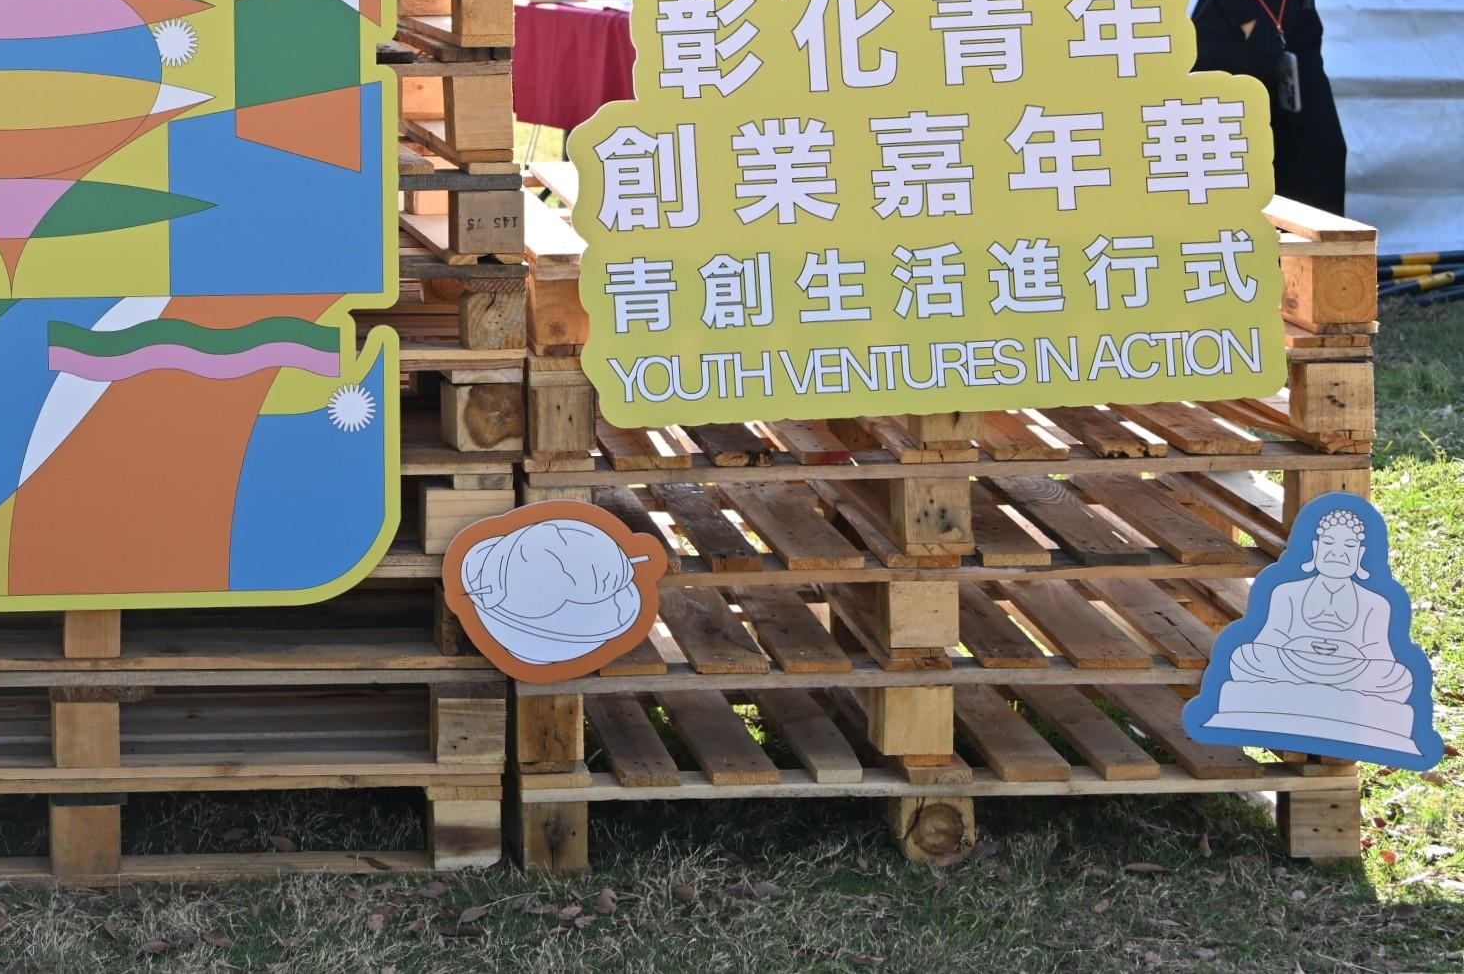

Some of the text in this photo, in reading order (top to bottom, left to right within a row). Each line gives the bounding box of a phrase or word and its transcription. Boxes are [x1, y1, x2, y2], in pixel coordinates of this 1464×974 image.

[593, 97, 1250, 233] 創業嘉年華
[604, 228, 1259, 334] 青創生活進行式
[606, 327, 1263, 403] YOUTH VENTURES IN ACTION
